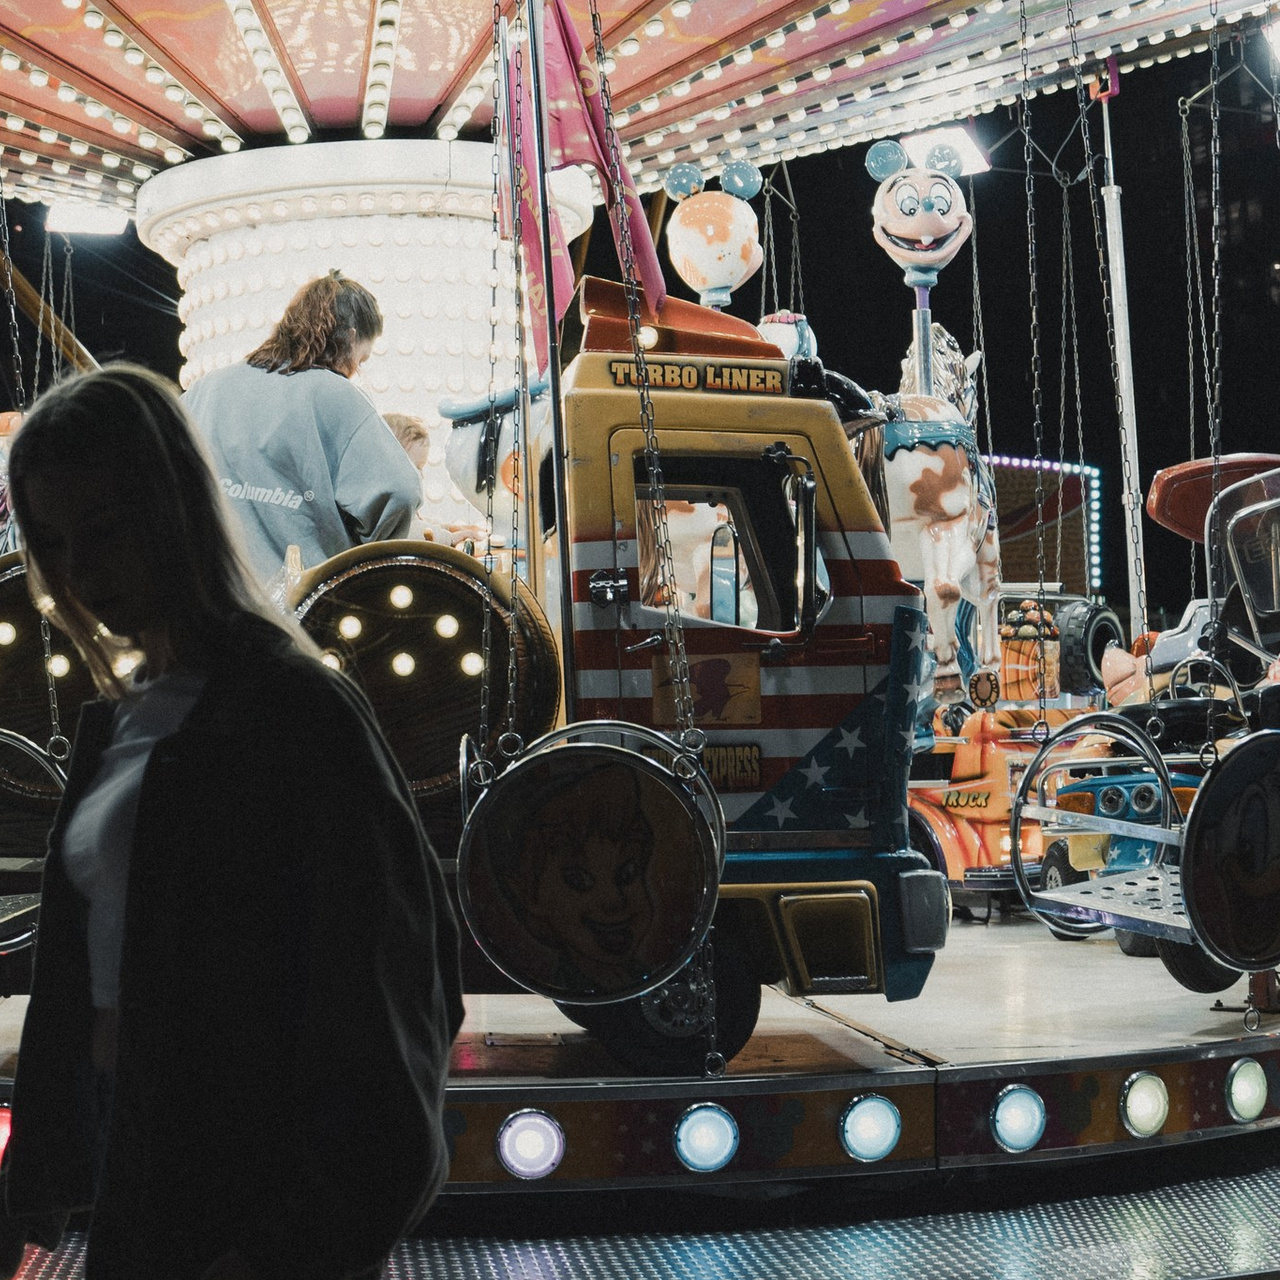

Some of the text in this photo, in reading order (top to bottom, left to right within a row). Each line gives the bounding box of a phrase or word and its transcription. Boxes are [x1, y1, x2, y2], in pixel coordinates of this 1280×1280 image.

[610, 361, 783, 394] TURBO LINER
[703, 745, 761, 787] EXPRESS
[941, 790, 991, 809] TRUCK
